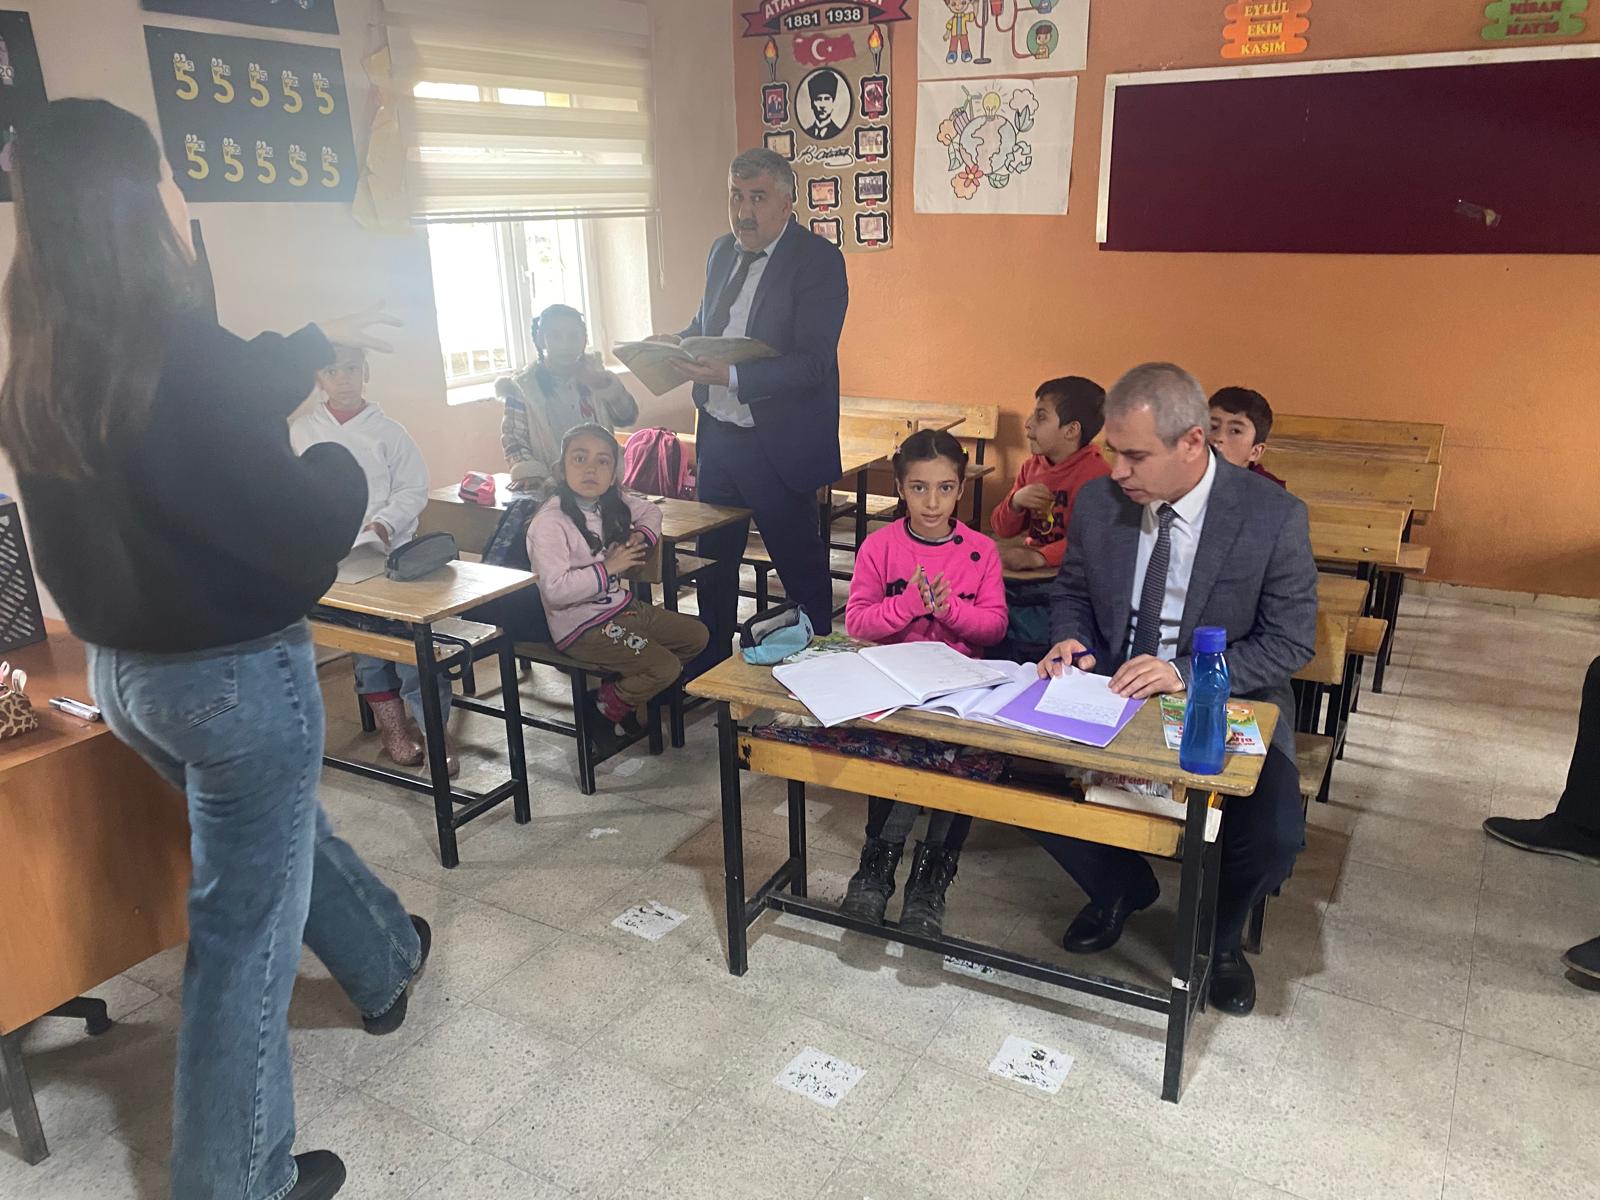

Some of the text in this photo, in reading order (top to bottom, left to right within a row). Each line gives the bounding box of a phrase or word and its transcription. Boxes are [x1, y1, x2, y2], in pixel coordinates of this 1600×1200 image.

[1245, 0, 1289, 16] EYLÜL
[786, 8, 861, 29] 1881 1938
[1248, 20, 1283, 36] EKİM
[1241, 41, 1286, 56] KASIM
[173, 56, 335, 115] 5 5 5 5 5
[185, 137, 340, 188] 5 5 5 5 5
